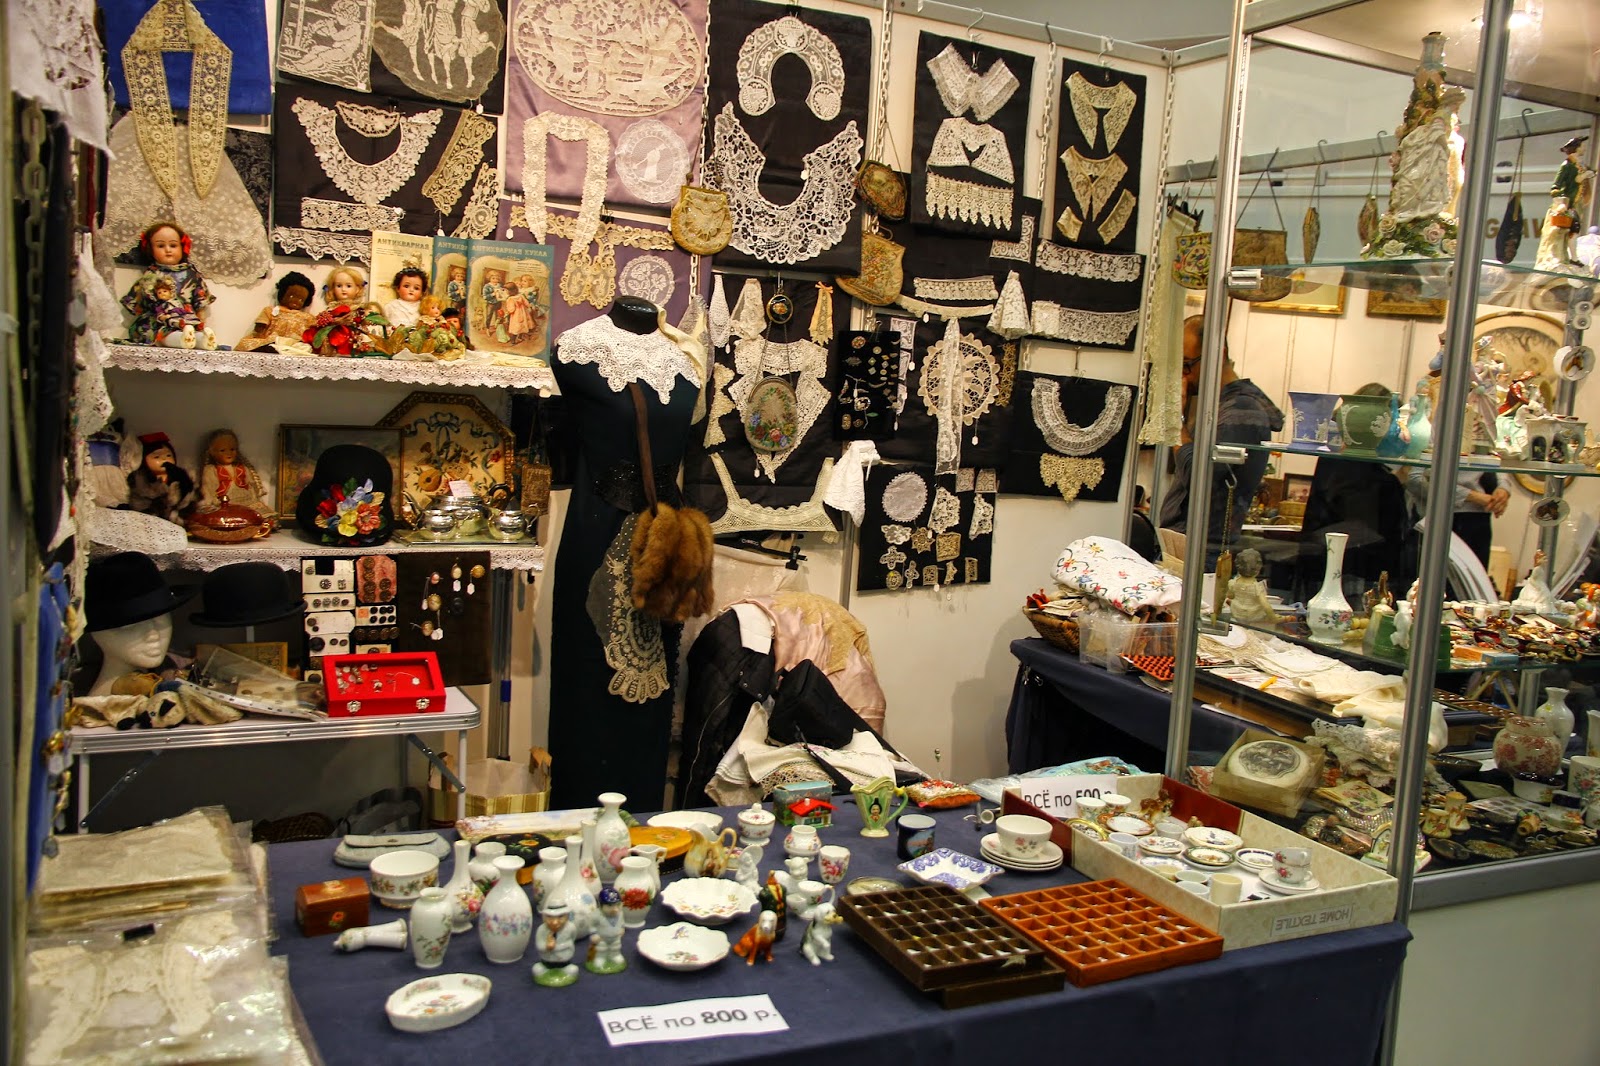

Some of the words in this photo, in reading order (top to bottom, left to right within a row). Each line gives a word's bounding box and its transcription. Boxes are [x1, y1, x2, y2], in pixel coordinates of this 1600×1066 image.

[377, 238, 430, 250] АНТИКВАРНАЯ
[471, 245, 523, 255] АНТИКВАРНАЯ
[524, 249, 548, 257] КУКЛА
[1024, 790, 1051, 809] ВСЁ
[1055, 795, 1072, 808] по
[1275, 914, 1318, 931] TEXTILE
[1319, 908, 1350, 924] HOME
[607, 1015, 657, 1034] ВСЁ
[664, 1016, 695, 1029] по
[701, 1009, 748, 1025] 800
[753, 1009, 777, 1022] р.
